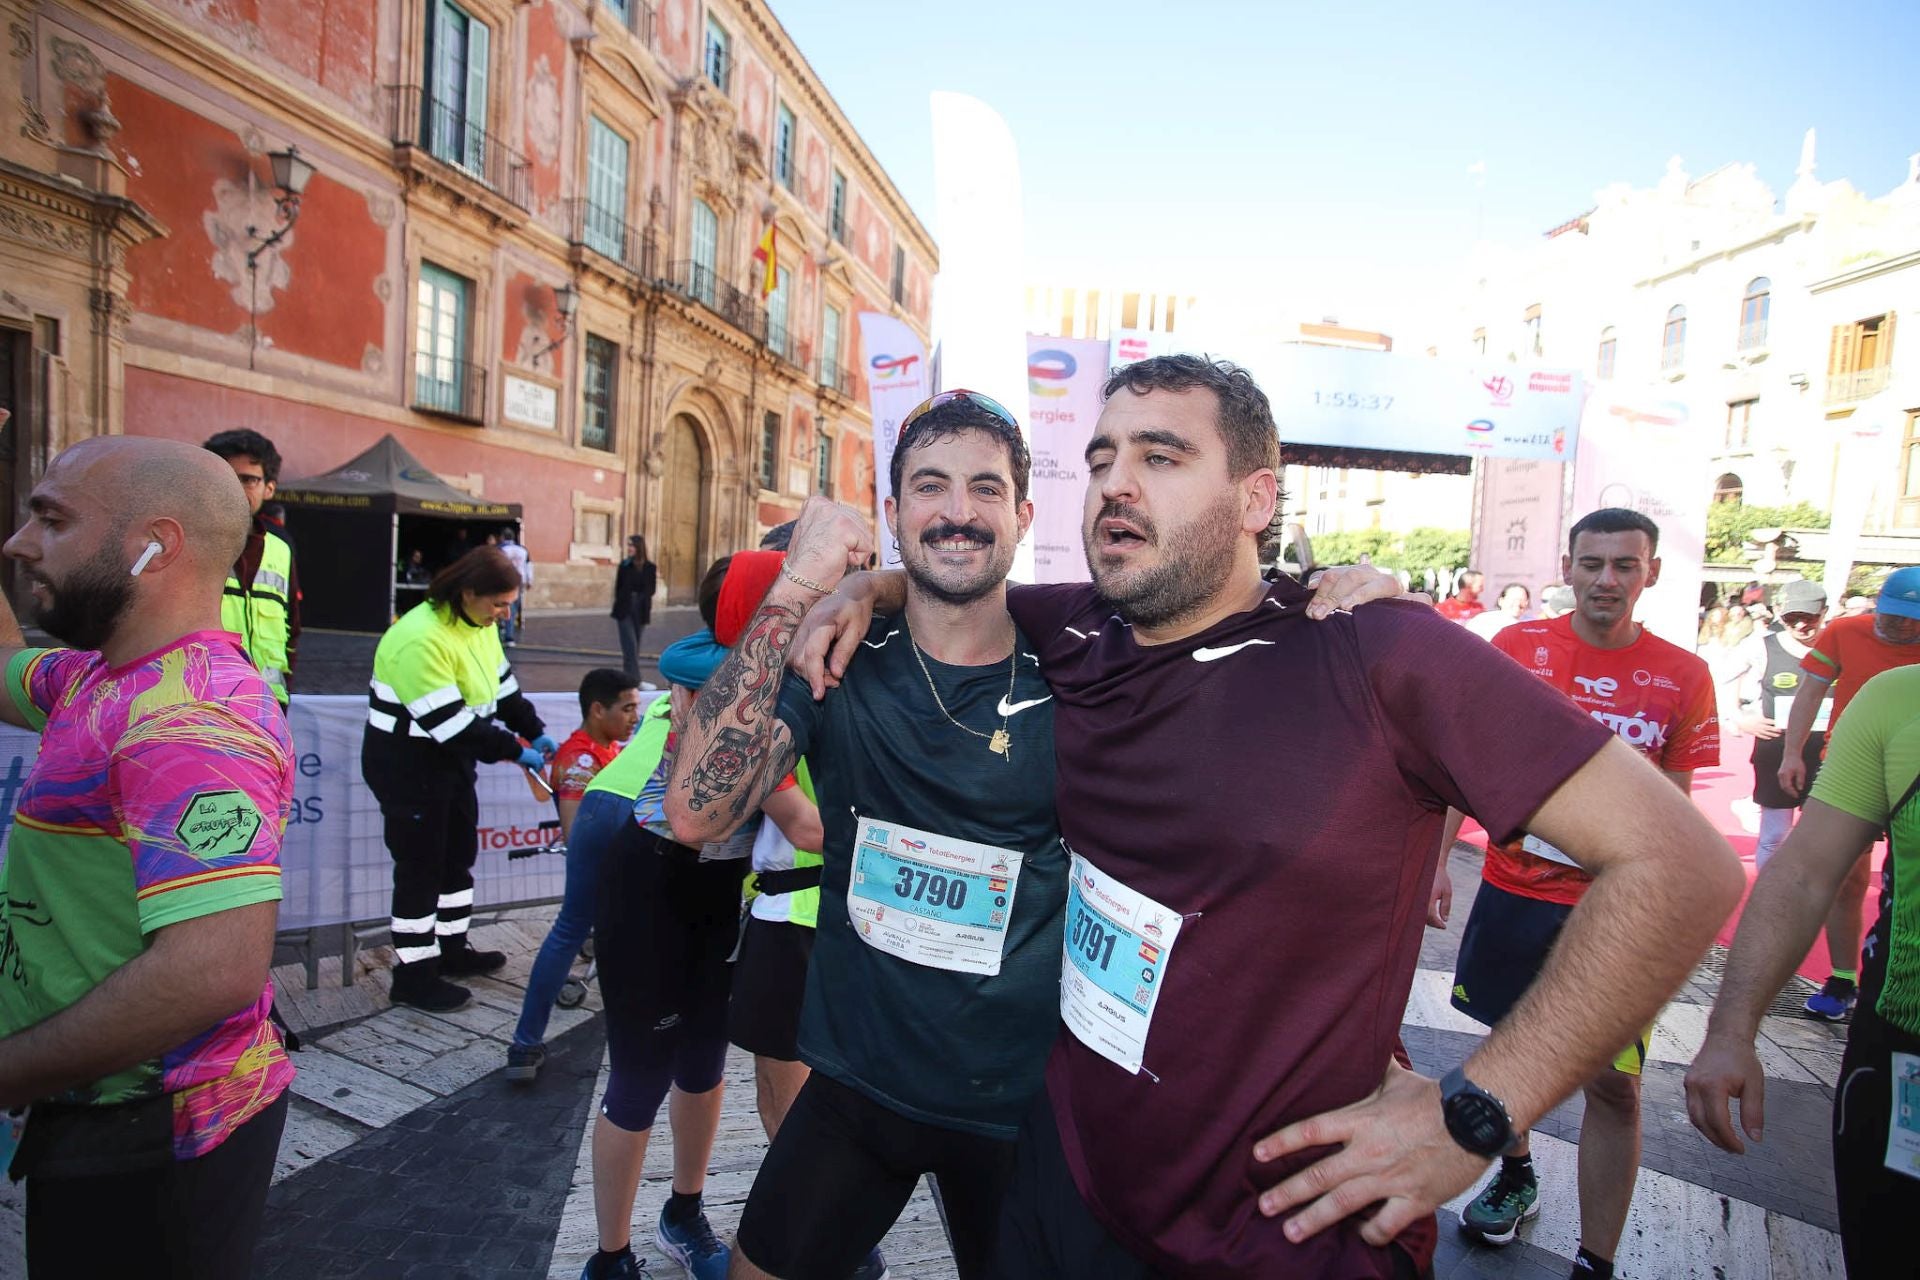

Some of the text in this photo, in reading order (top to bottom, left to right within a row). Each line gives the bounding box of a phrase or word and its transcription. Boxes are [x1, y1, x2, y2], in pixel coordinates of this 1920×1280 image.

[1314, 391, 1395, 411] 1:55:37
[200, 802, 217, 814] LA
[929, 847, 976, 863] TotalEnergies
[894, 866, 968, 911] 3790
[1094, 887, 1131, 916] TotalEnergies
[1073, 907, 1118, 972] 3791
